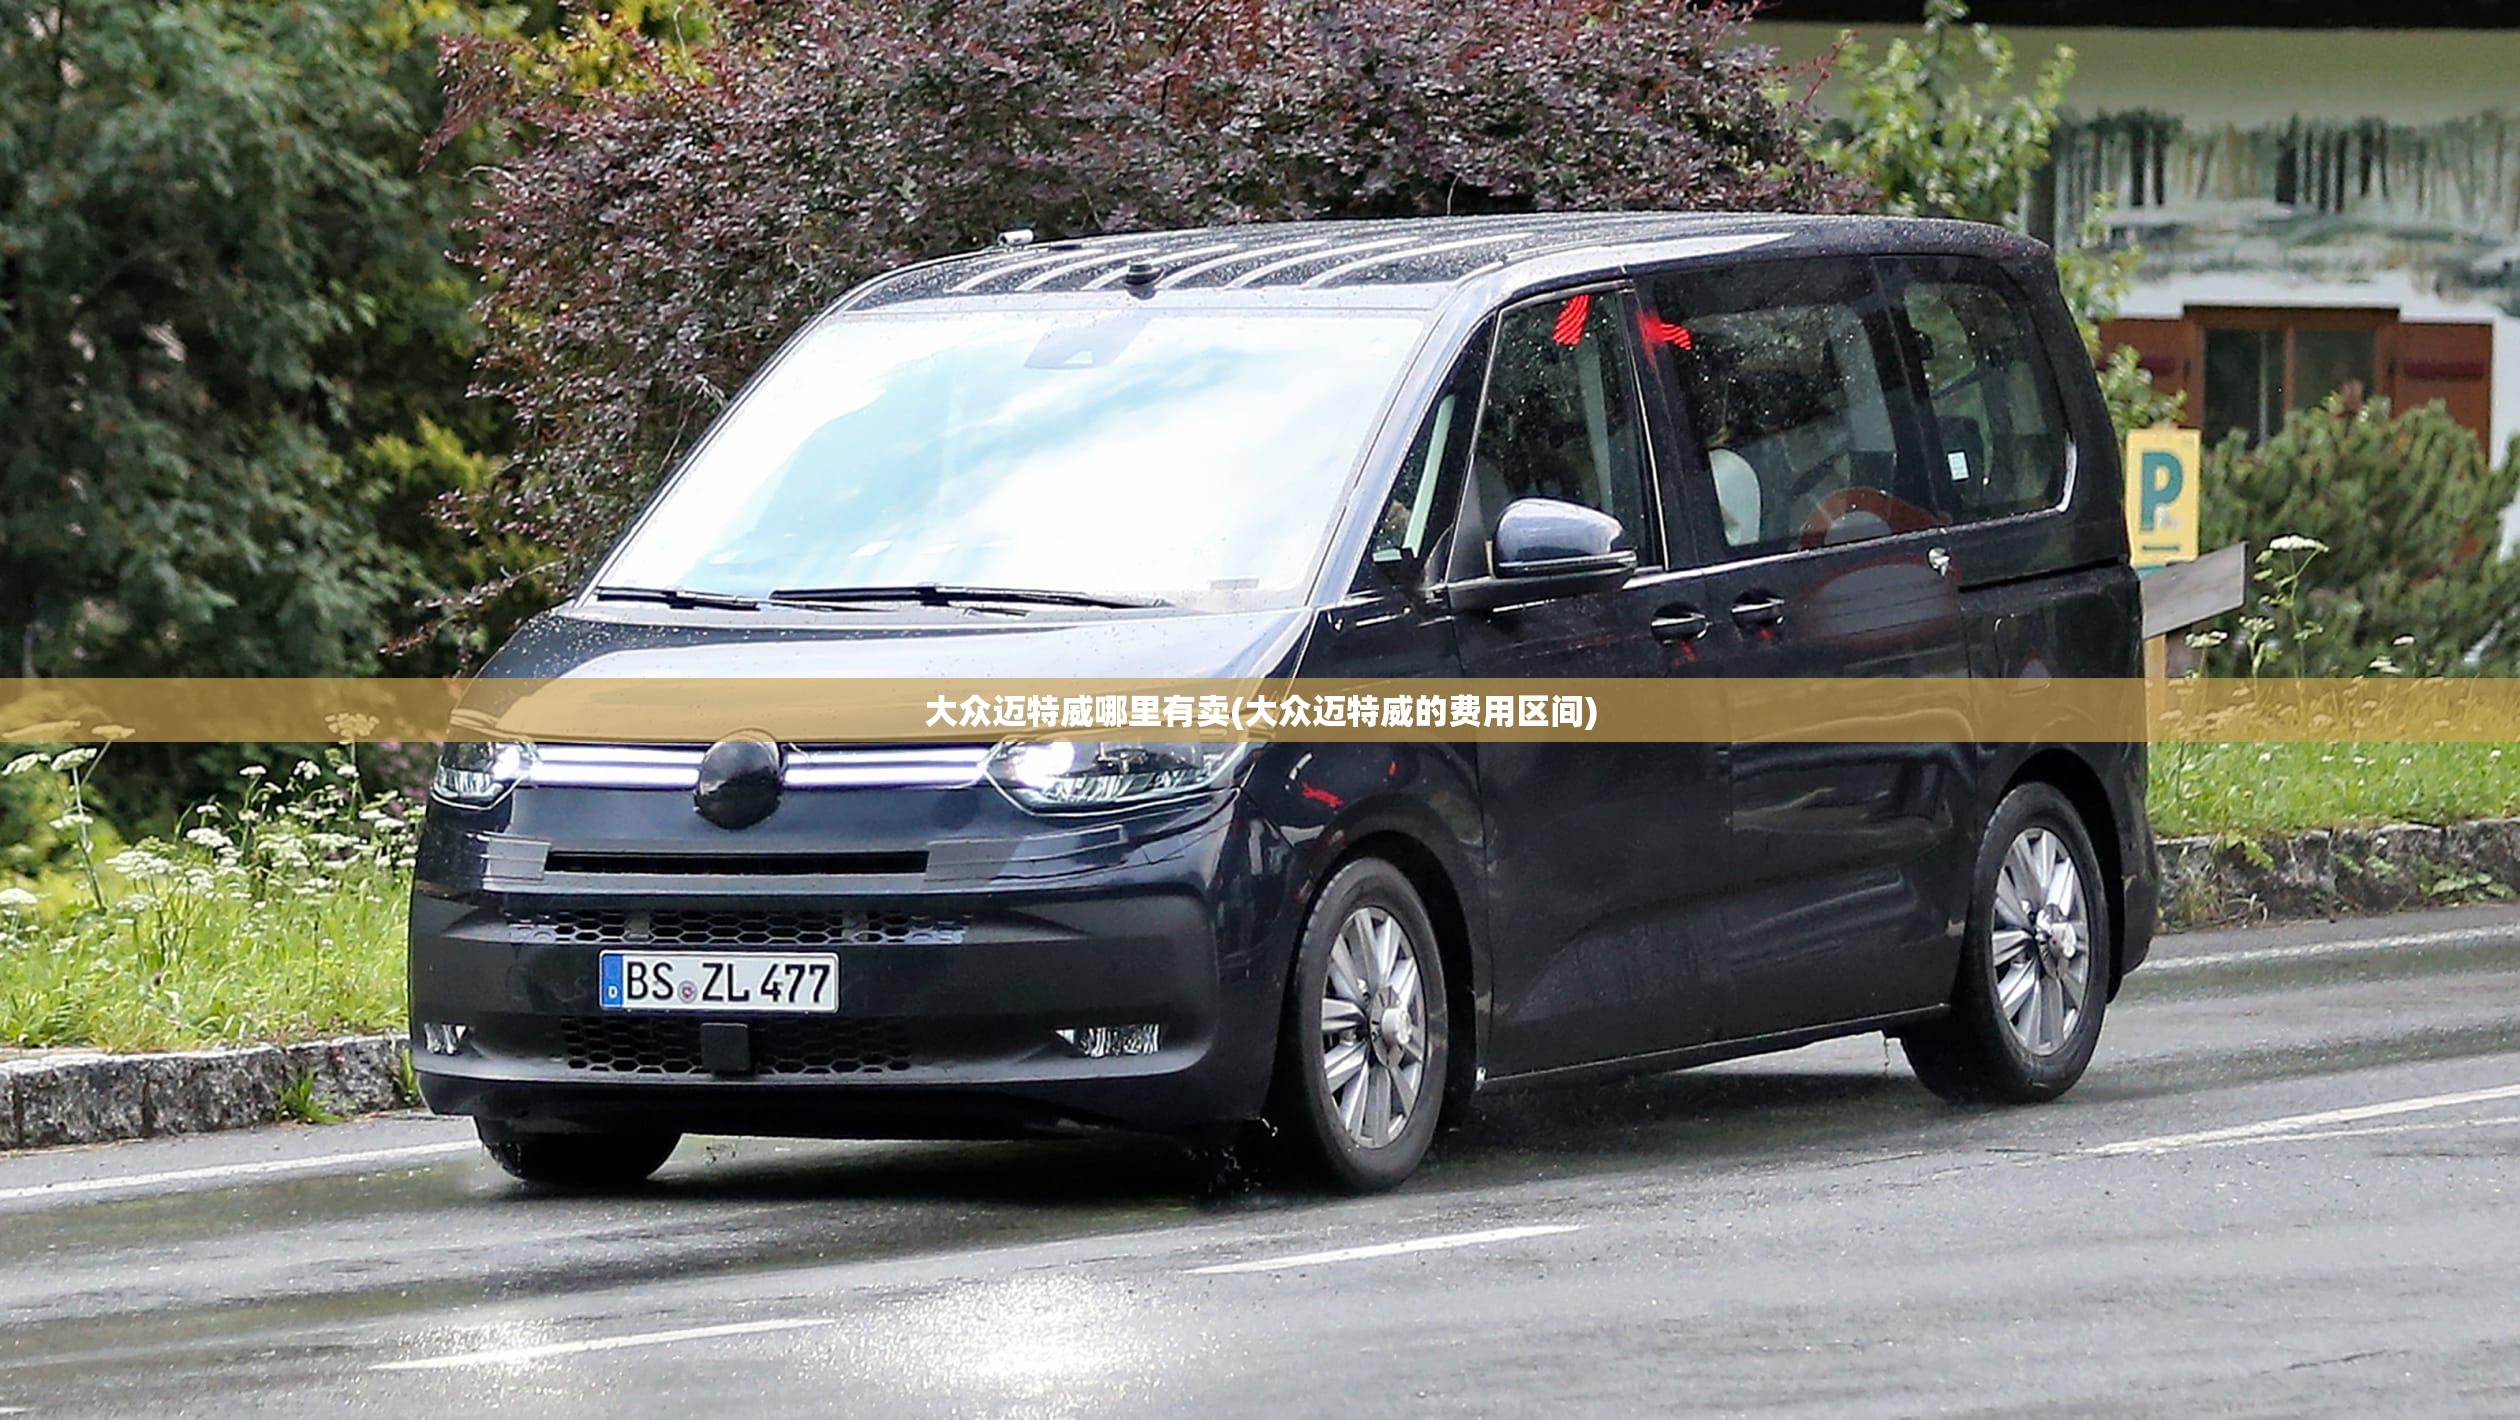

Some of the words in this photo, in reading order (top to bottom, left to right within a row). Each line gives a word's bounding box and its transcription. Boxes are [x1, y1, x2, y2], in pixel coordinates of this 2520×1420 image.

[2140, 451, 2183, 531] P
[627, 961, 674, 1001] BS
[702, 963, 749, 1002] ZL
[760, 963, 831, 1003] 477
